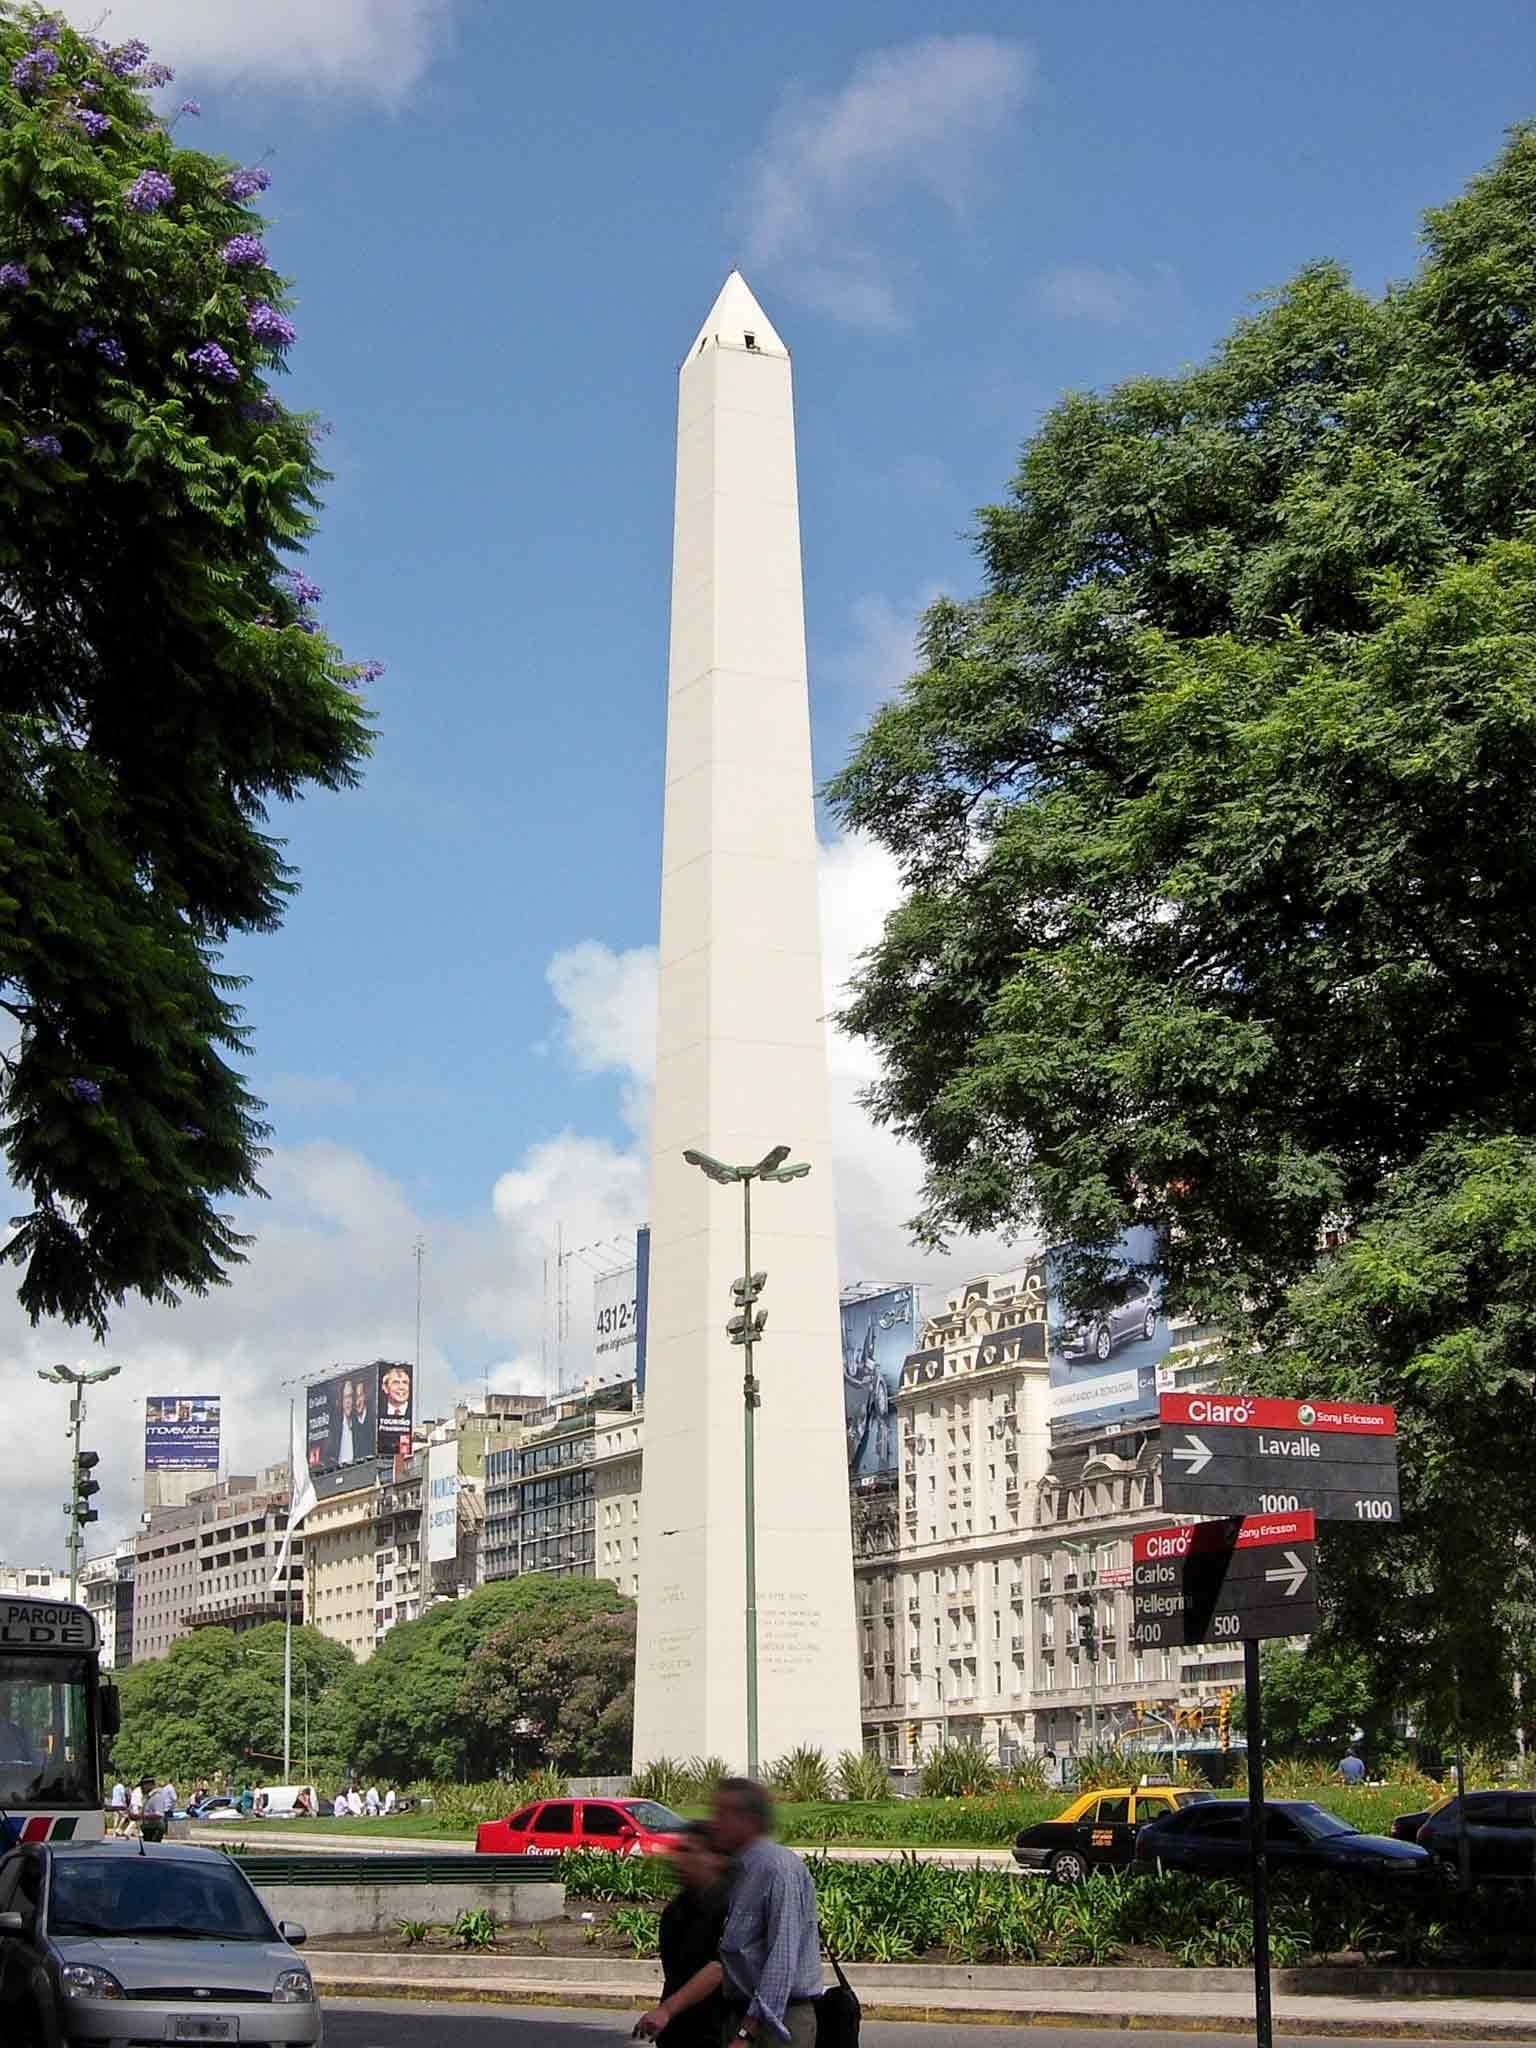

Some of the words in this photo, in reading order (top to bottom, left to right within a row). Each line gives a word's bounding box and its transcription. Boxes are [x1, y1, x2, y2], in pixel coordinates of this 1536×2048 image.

[1188, 1400, 1250, 1423] Claro
[1317, 1412, 1342, 1425] Sony
[1343, 1414, 1384, 1425] Ericsson
[1259, 1436, 1320, 1457] Lavalle
[1259, 1494, 1298, 1513] 1000
[1355, 1501, 1392, 1519] 1100
[1239, 1528, 1259, 1539] Sony
[1261, 1524, 1297, 1536] Ericsson
[1147, 1533, 1188, 1558] Claro
[1135, 1564, 1175, 1585] Carlos
[8, 1606, 82, 1624] PARQUE
[1136, 1624, 1161, 1642] 400
[1214, 1615, 1240, 1636] 500
